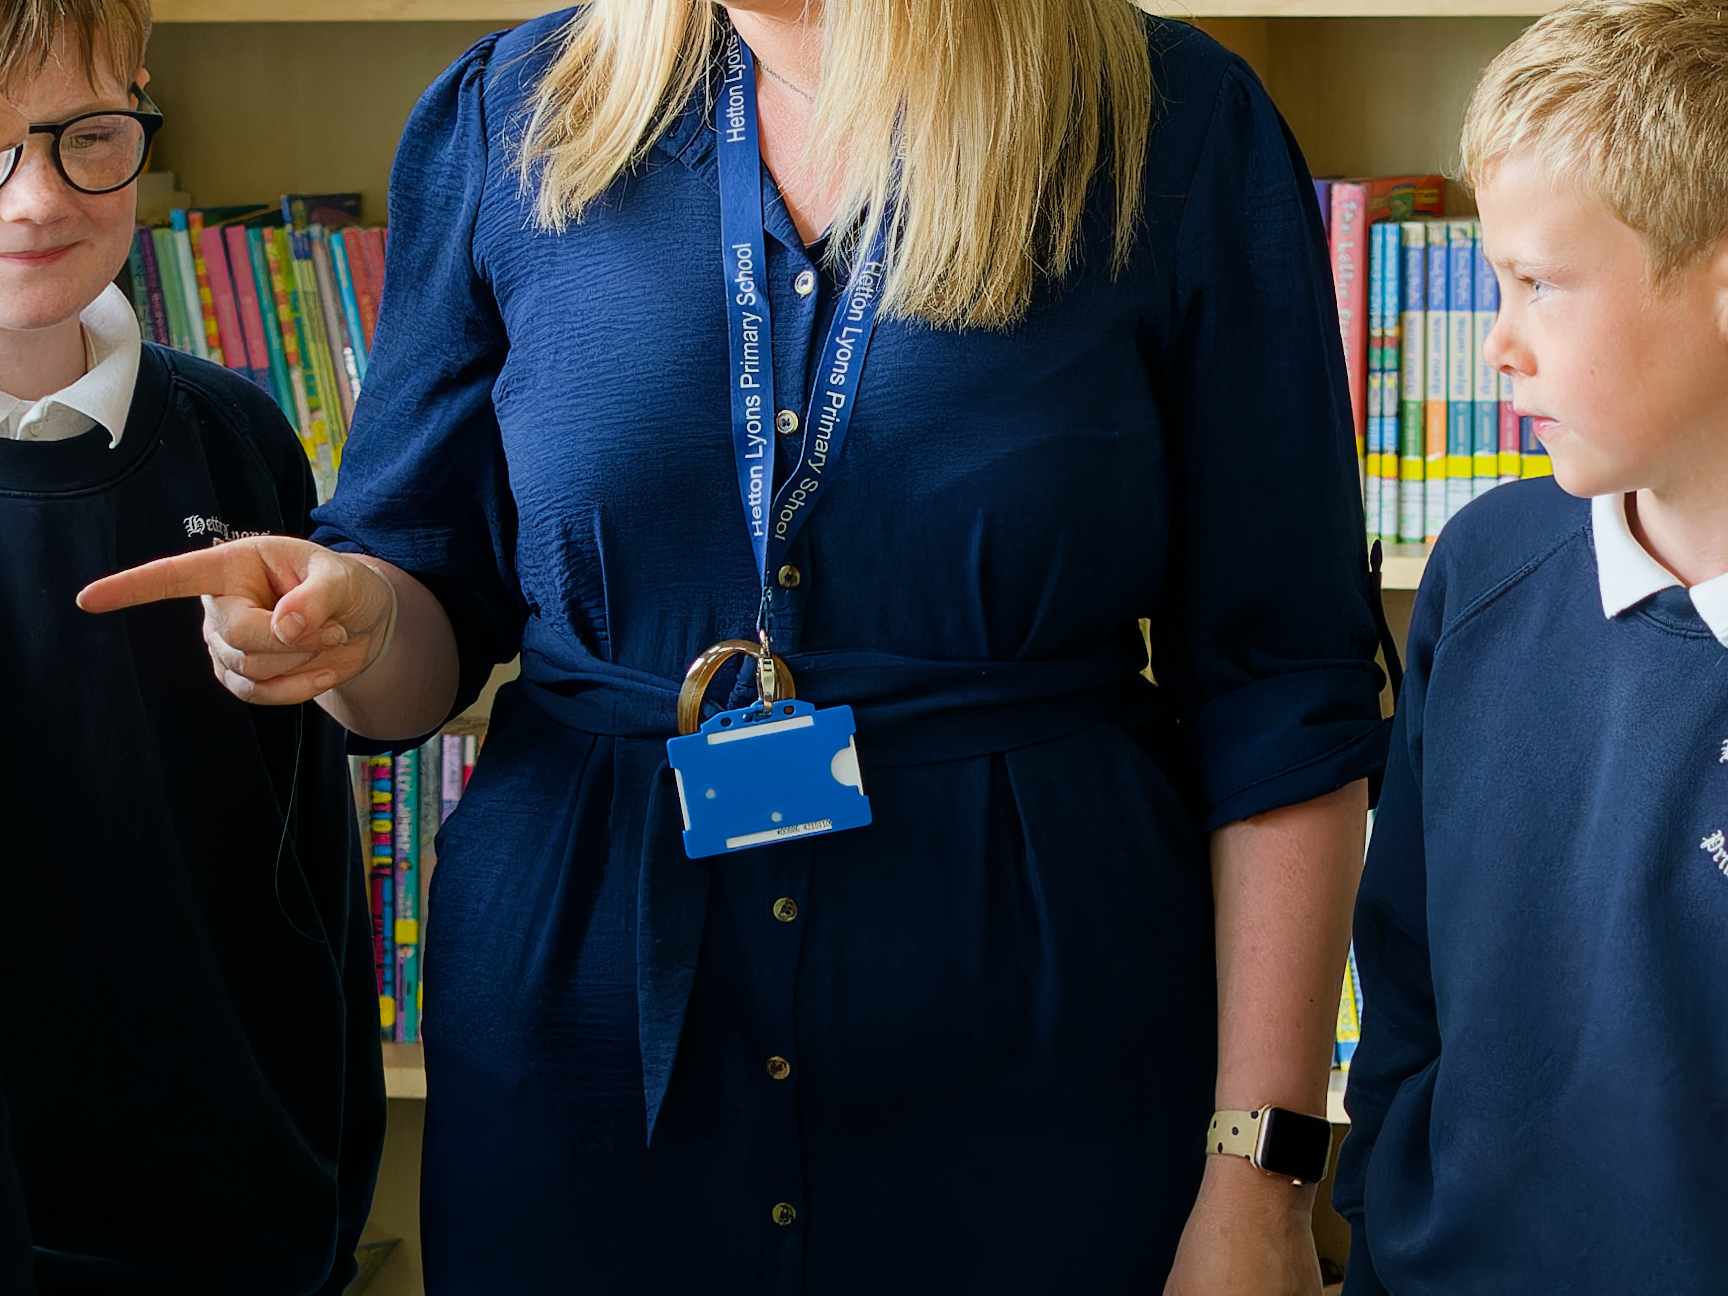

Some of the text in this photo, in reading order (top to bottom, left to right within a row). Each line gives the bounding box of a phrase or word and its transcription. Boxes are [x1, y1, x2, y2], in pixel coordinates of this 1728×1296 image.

[725, 34, 746, 143] Hetton Lyons
[731, 242, 768, 537] Hetton Lyons Primary School
[775, 260, 883, 542] Hetton Lyons Primary School
